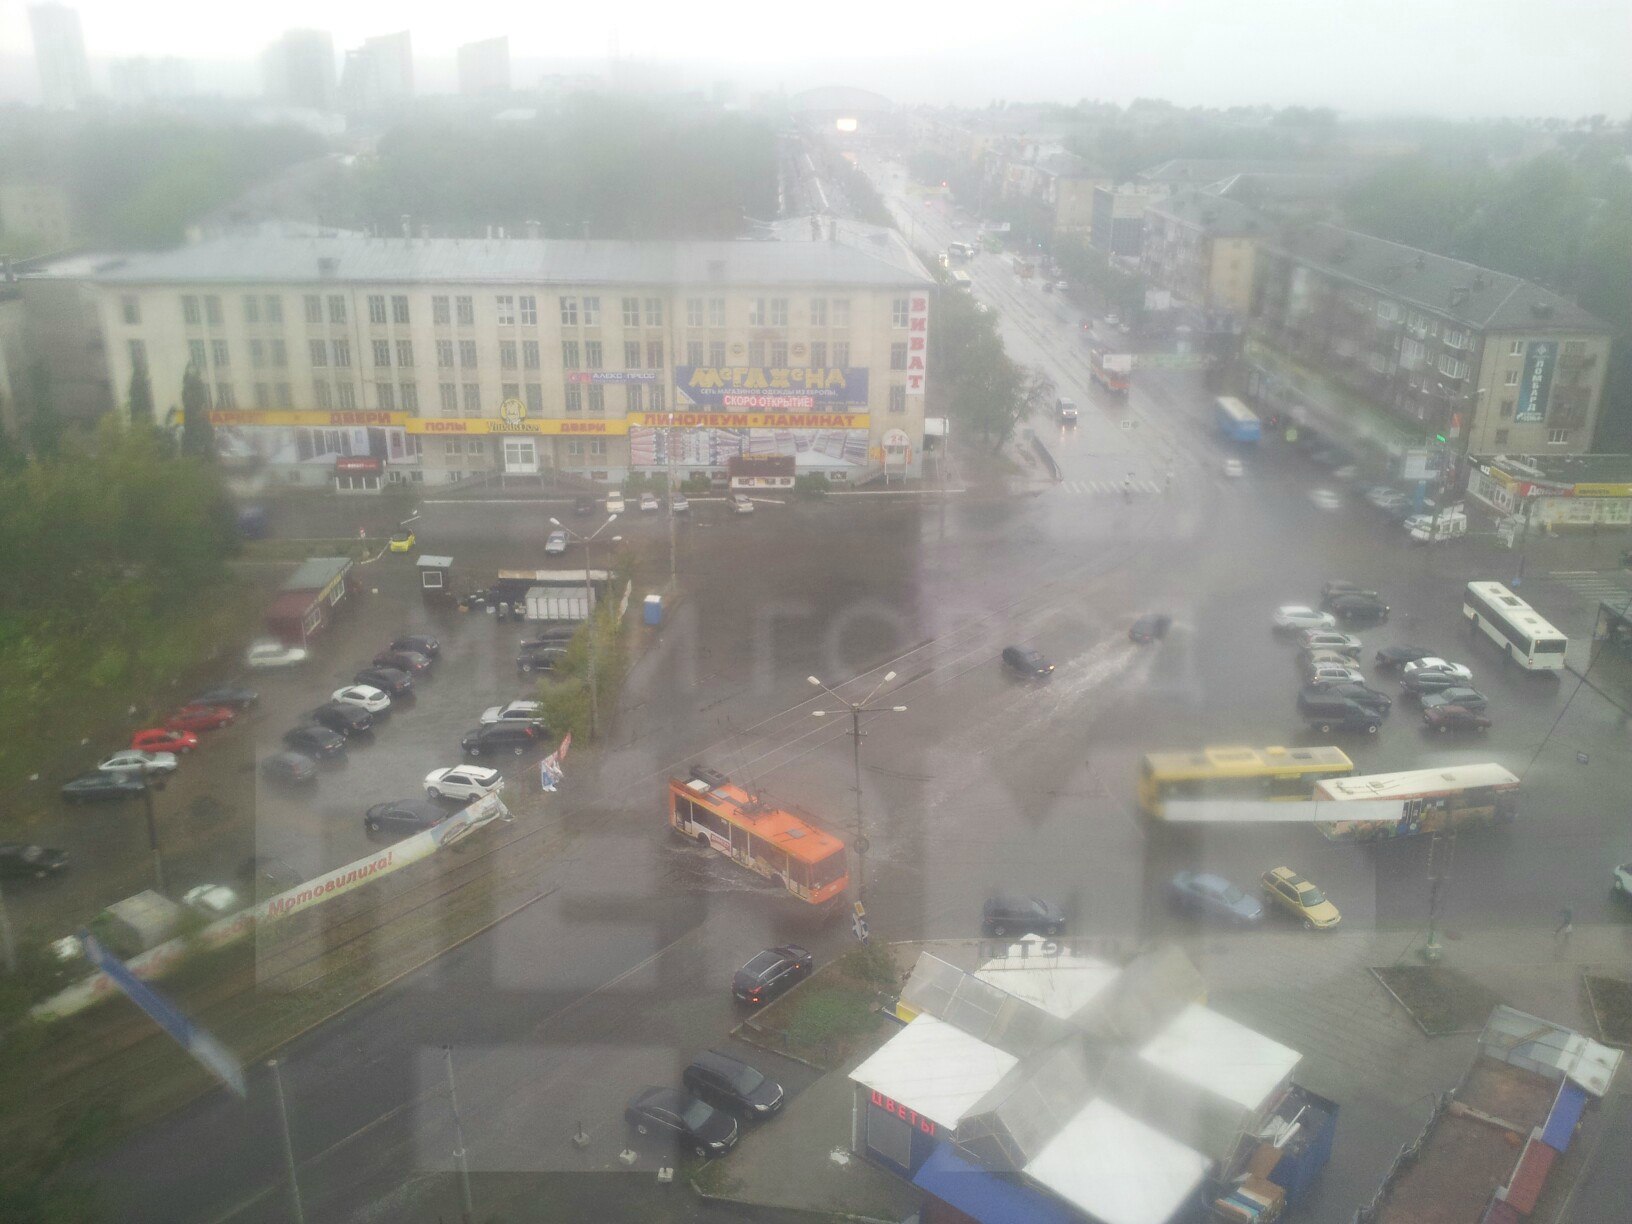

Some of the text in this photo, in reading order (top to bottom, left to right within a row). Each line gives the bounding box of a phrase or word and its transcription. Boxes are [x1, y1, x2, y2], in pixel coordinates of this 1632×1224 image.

[908, 298, 926, 389] ВИВАТ
[724, 395, 757, 406] СКОРО
[758, 396, 814, 408] ОТКРЫТИЕ!
[330, 412, 391, 424] ДВЕРИ
[644, 413, 856, 427] ЛИНОЛЕУМ ЛАМИНАТ
[425, 421, 467, 431] ПОЛЫ
[561, 422, 606, 433] ДВЕРИ
[268, 851, 393, 918] Мотовилиха!
[871, 1089, 935, 1137] ЦВЕТЫ
